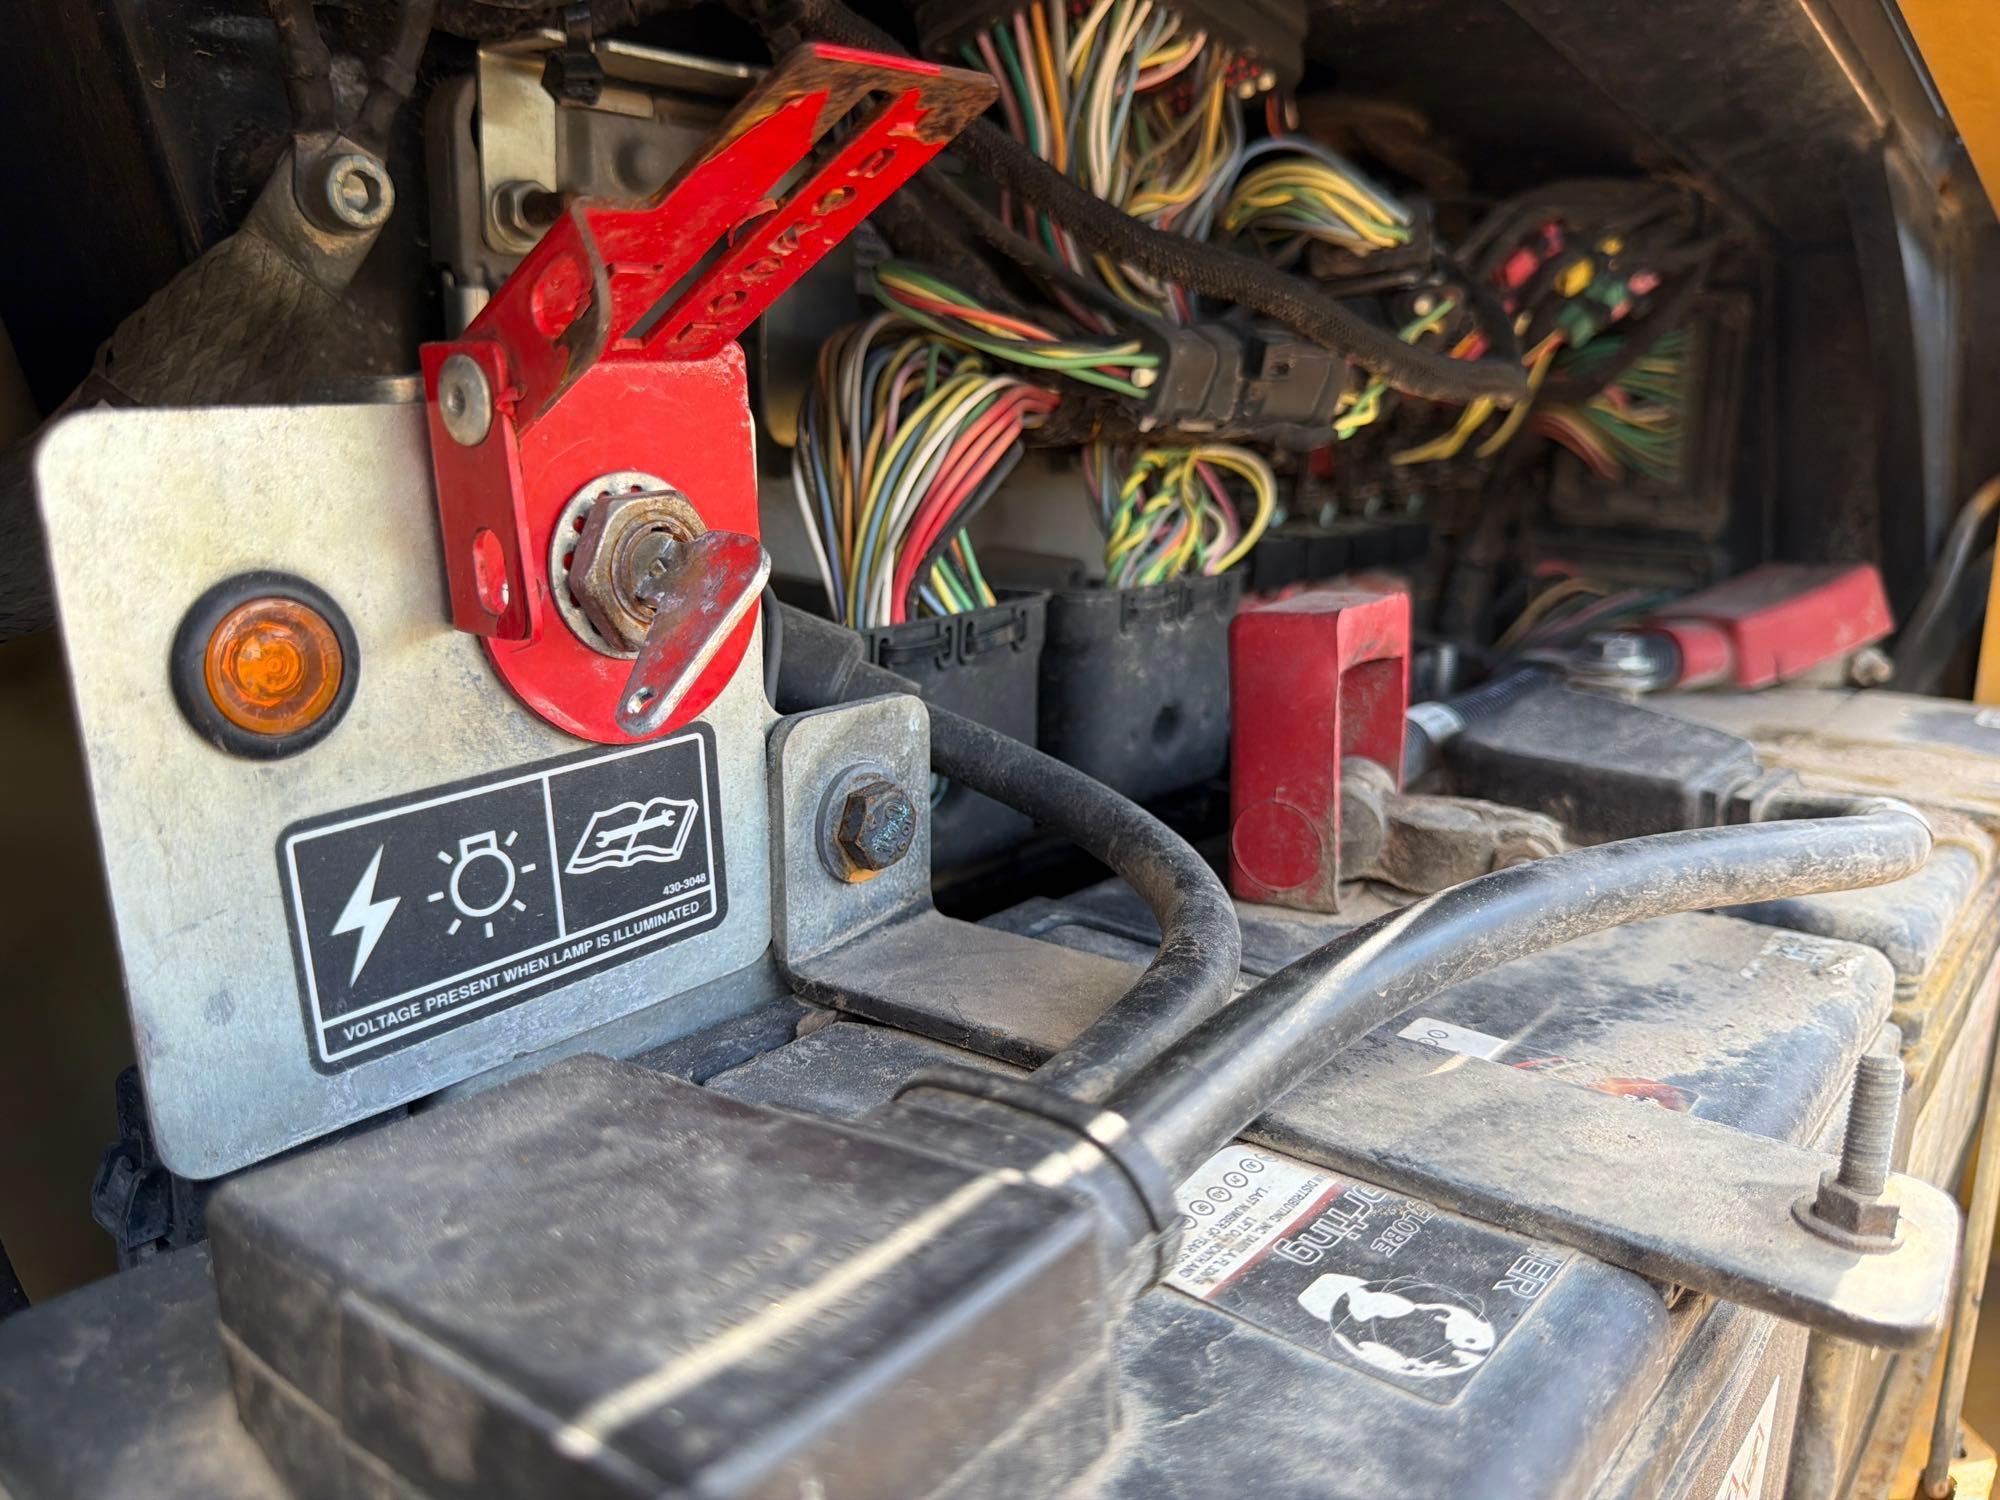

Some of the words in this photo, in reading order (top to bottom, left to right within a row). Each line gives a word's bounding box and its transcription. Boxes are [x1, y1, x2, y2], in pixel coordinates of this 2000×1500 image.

[662, 873, 707, 896] 430-3048
[342, 997, 422, 1042] VOLTAGE
[425, 973, 500, 1014] PRESENT
[502, 954, 550, 984] WHEN
[552, 939, 594, 965] LAMP
[596, 932, 610, 948] IS
[612, 901, 700, 944] ILLUMINATED
[1244, 1187, 1268, 1204] LAST
[1215, 1203, 1249, 1228] NUMBER
[1236, 1216, 1256, 1230] LIFT
[1203, 1227, 1220, 1238] OF
[1184, 1236, 1209, 1252] YEAR
[1176, 1261, 1200, 1278] AND
[1493, 1244, 1569, 1299] ER
